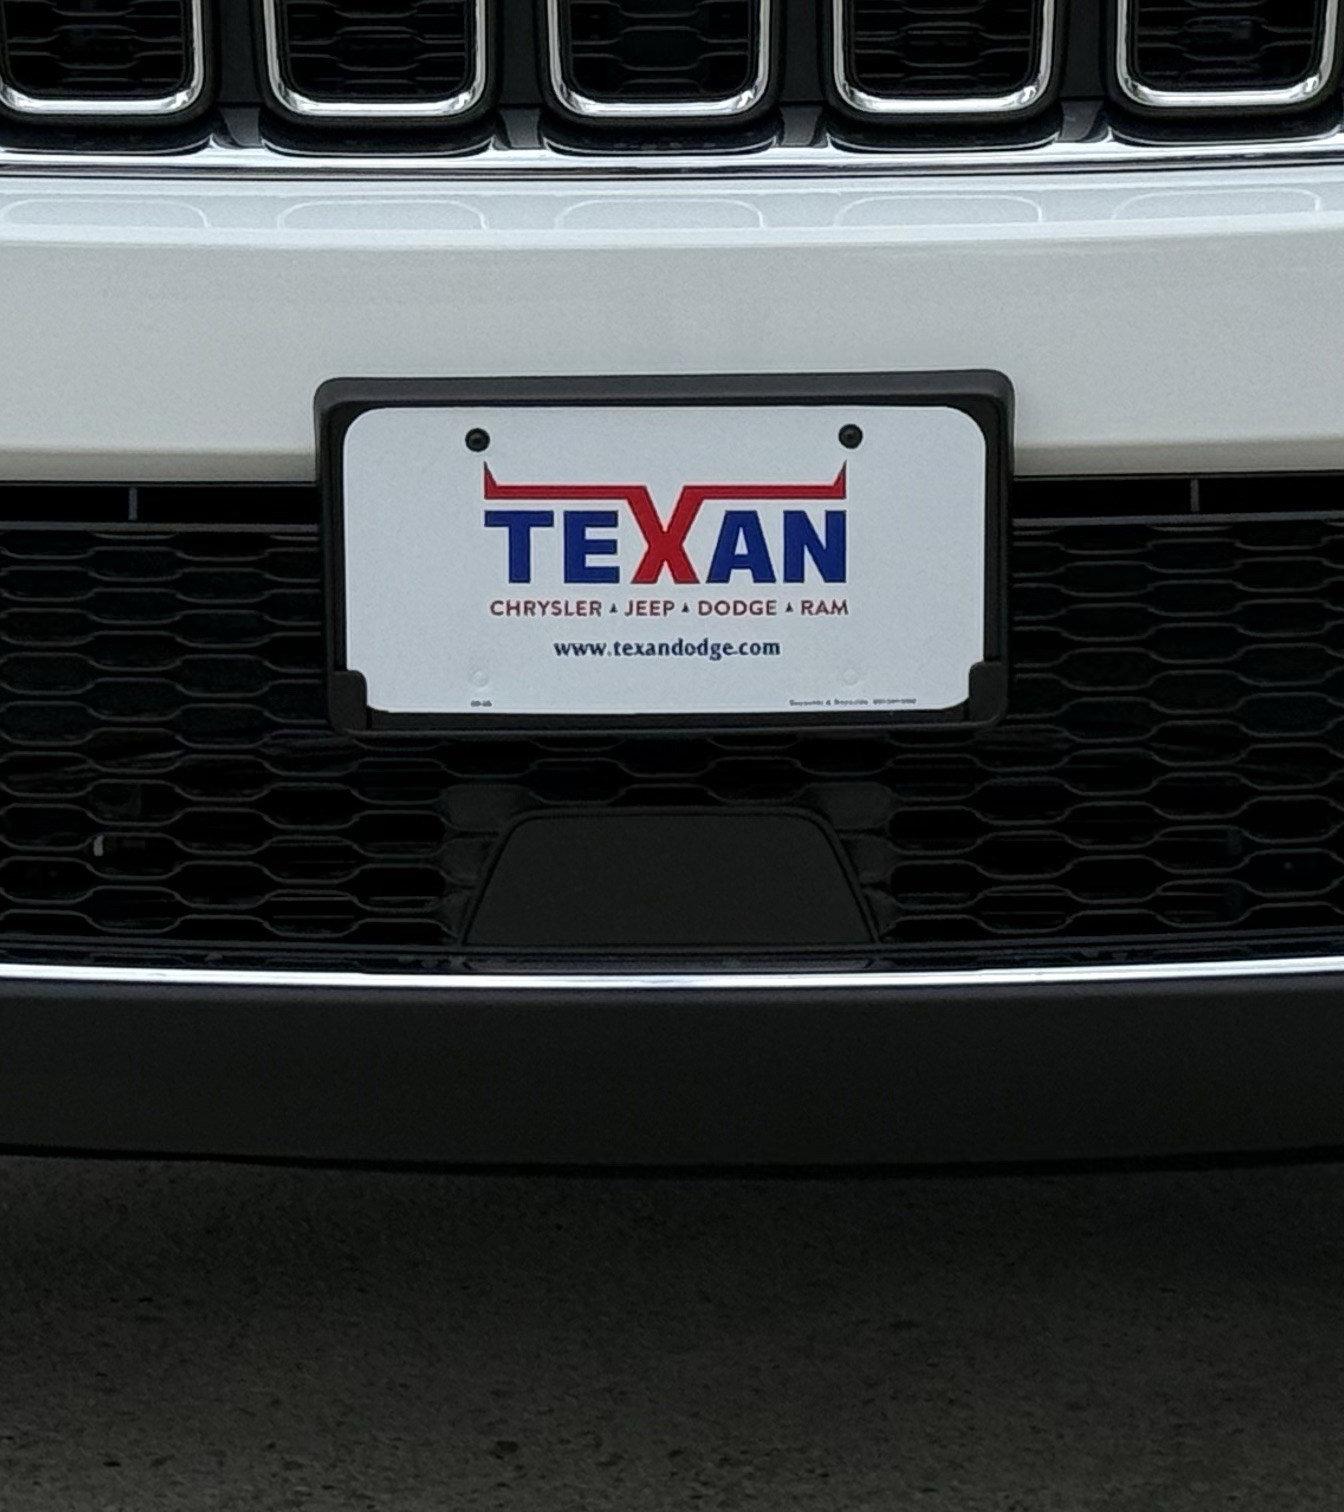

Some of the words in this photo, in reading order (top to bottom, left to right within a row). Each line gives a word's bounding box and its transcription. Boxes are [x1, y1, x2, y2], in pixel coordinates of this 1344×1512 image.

[483, 485, 847, 585] TEXAN
[489, 599, 603, 617] CHRYSLER
[623, 599, 676, 617] JEEP
[697, 599, 778, 617] DODGE
[800, 598, 850, 616] RAM
[553, 637, 782, 662] www.texandodge.com
